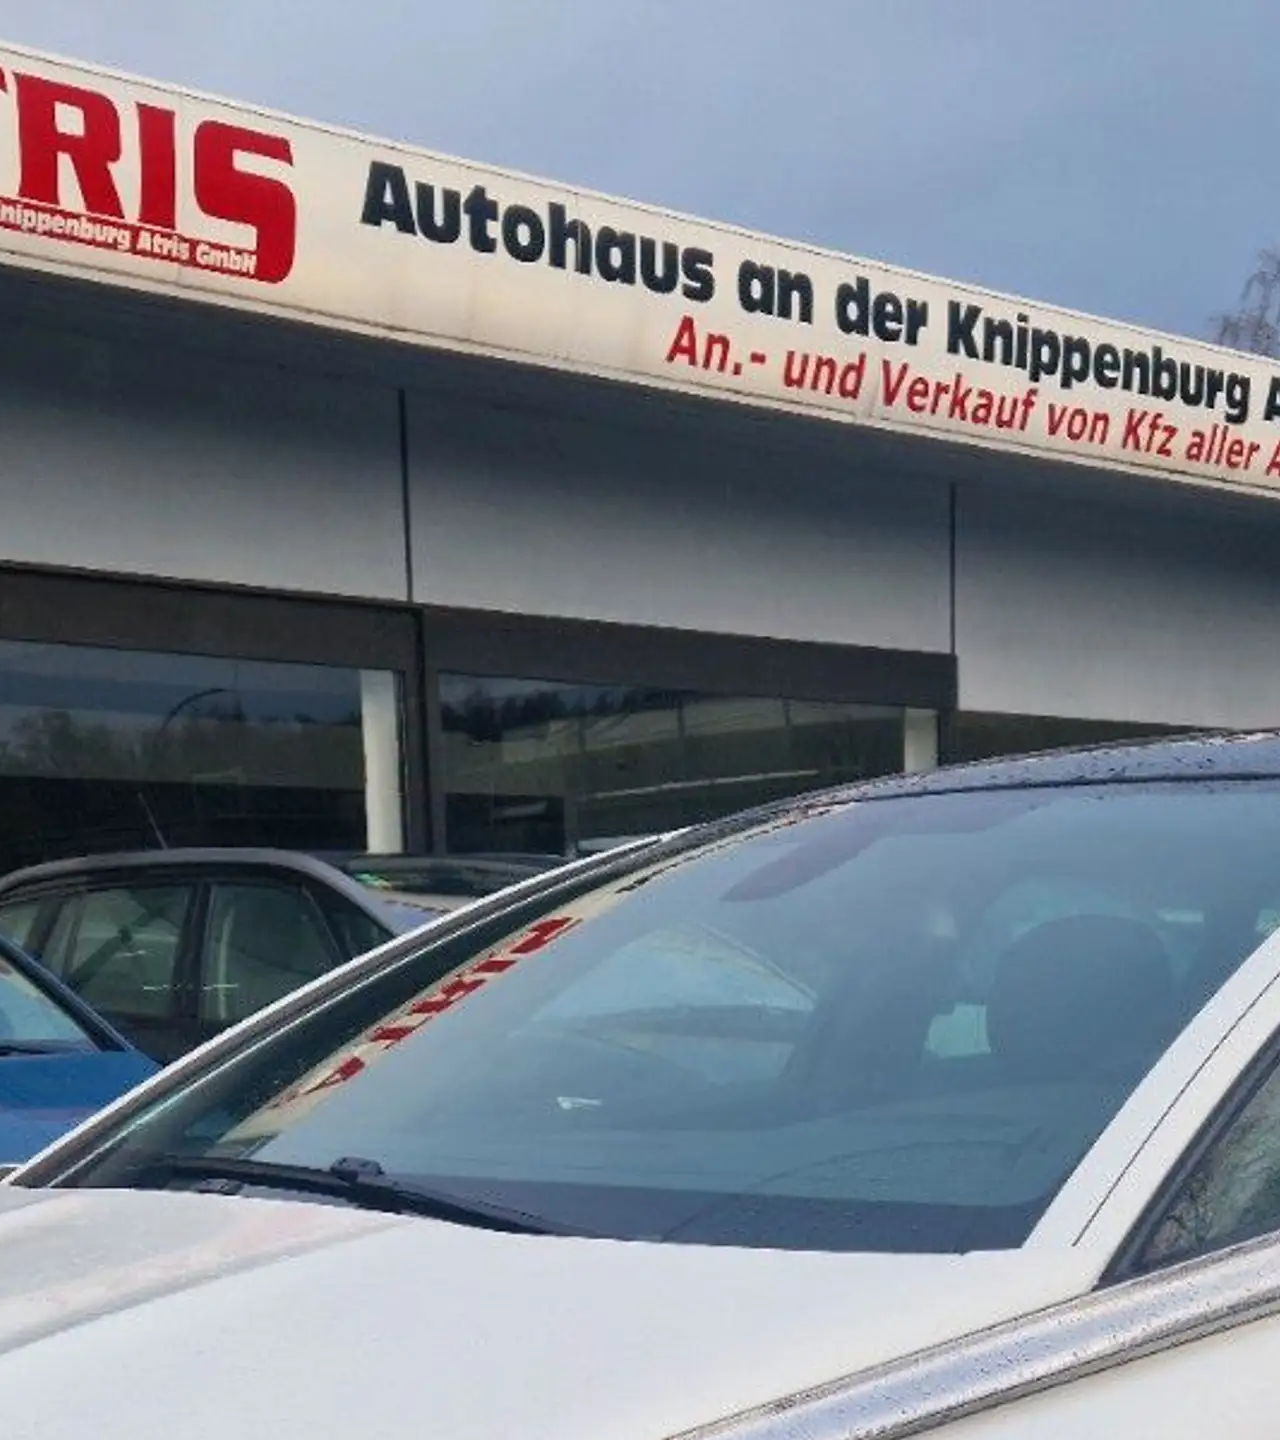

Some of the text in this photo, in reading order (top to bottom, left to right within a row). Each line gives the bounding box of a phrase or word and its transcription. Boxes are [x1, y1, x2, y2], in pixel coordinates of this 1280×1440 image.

[136, 231, 190, 261] Atris
[195, 243, 258, 276] GmbH
[360, 160, 715, 302] Autohaus
[737, 260, 814, 324] an
[835, 276, 928, 347] der
[947, 299, 1251, 425] Knippenburg
[666, 315, 766, 376] An.-
[783, 350, 867, 400] und
[881, 359, 1038, 432] Verkauf
[1047, 401, 1110, 446] von
[1121, 407, 1177, 457] Kfz
[1185, 421, 1261, 472] aller
